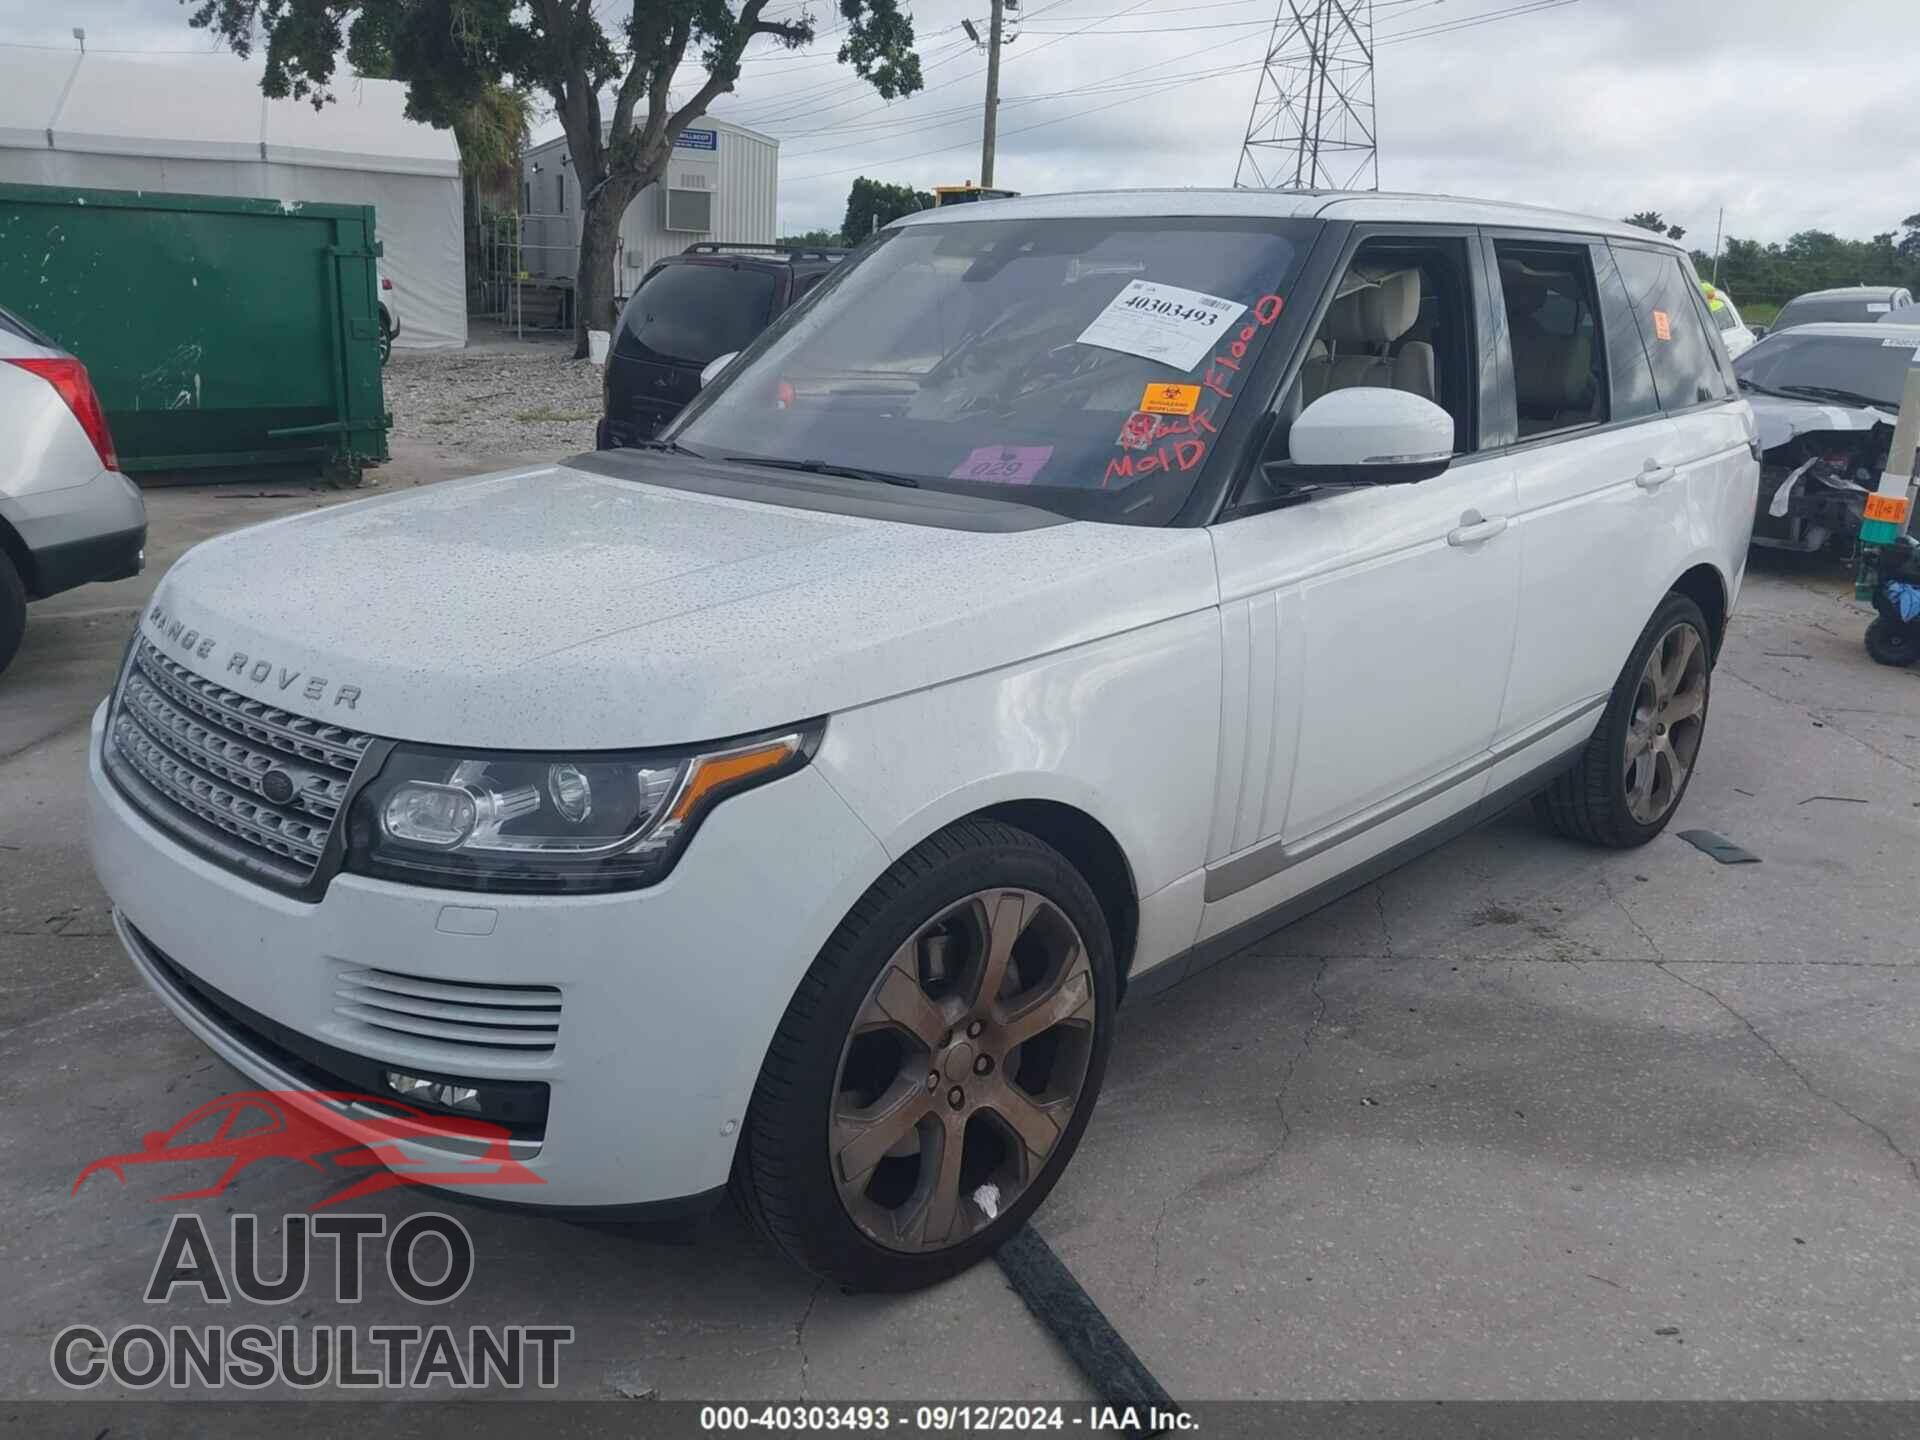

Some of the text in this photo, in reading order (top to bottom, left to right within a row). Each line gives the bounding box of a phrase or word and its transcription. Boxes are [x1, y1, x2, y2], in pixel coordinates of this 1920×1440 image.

[1125, 296, 1218, 325] 40303493
[150, 606, 362, 709] RANGE ROVER
